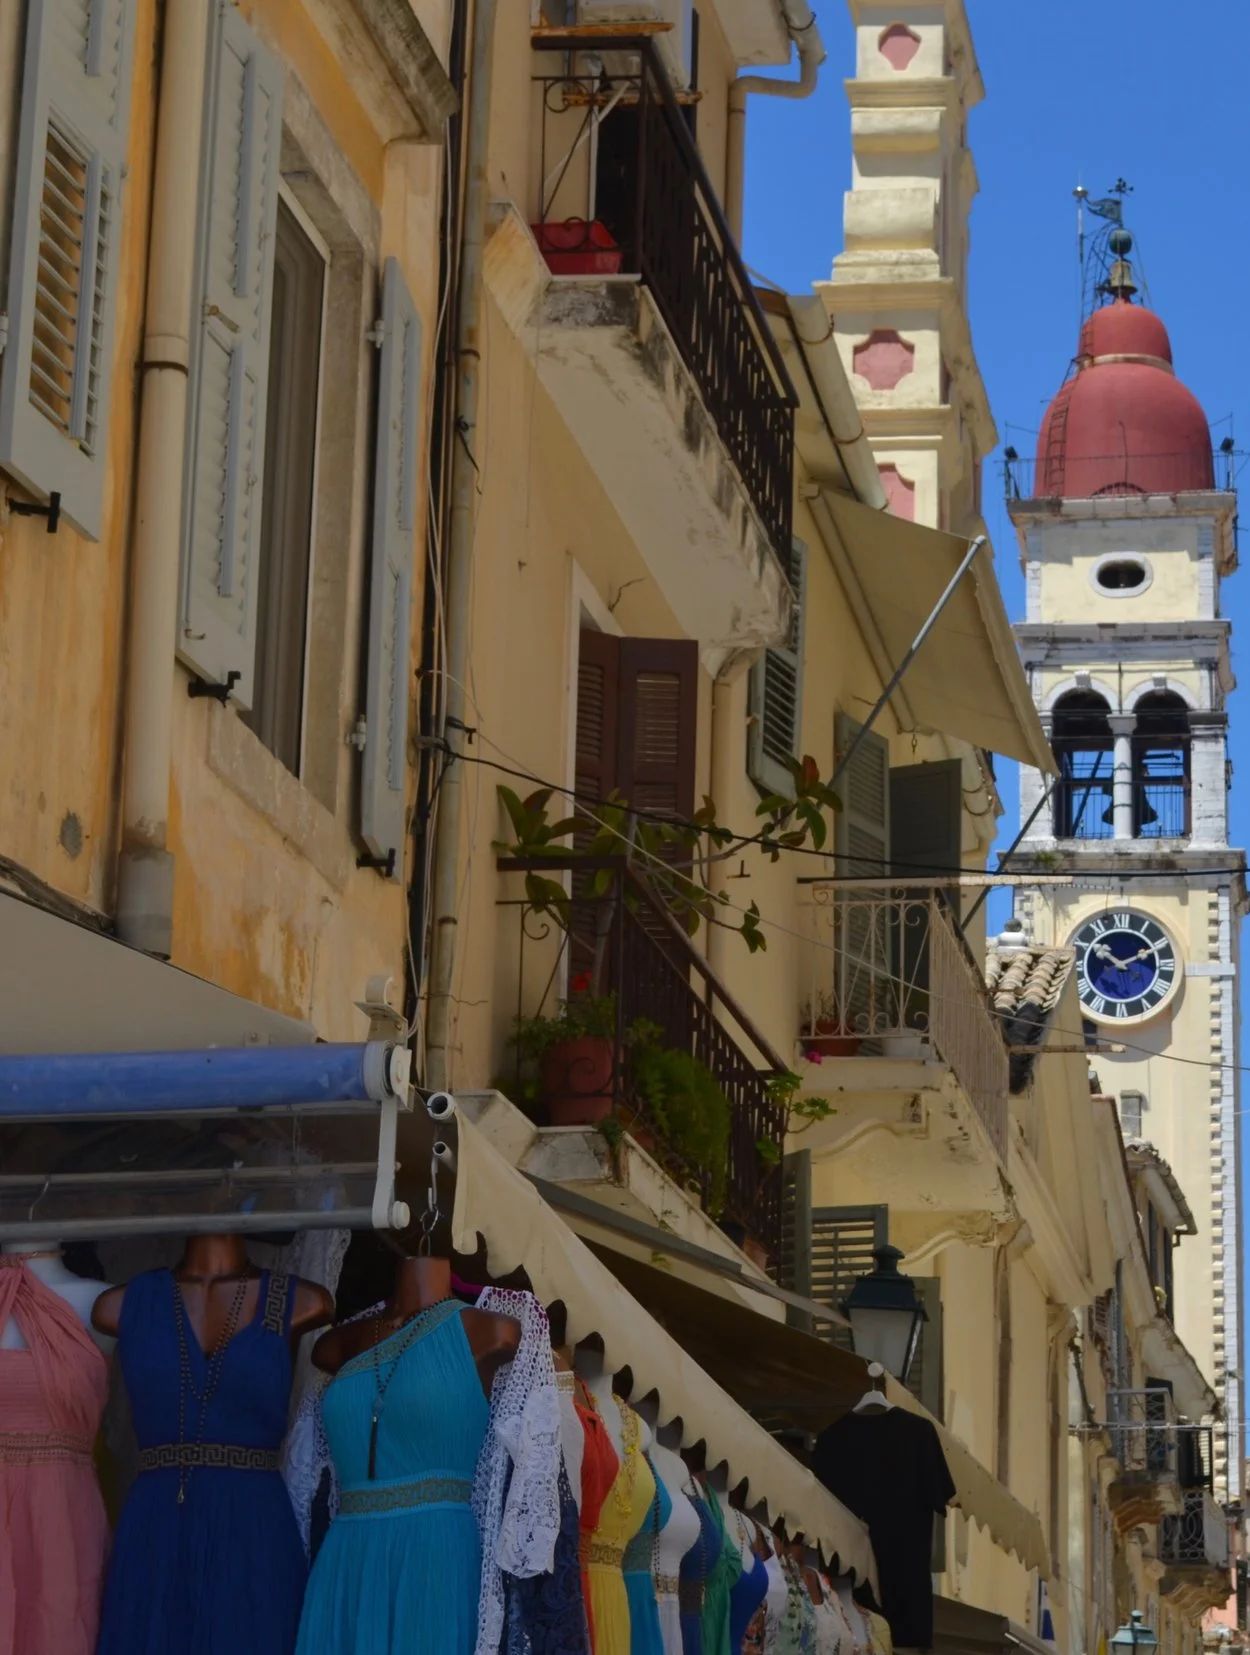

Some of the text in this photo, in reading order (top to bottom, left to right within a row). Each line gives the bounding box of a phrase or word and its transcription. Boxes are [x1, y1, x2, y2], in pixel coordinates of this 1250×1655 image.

[1090, 919, 1105, 936] XI
[1113, 913, 1130, 928] XII
[1140, 920, 1150, 934] I
[1160, 959, 1175, 970] III
[1090, 996, 1105, 1014] VII
[1116, 1003, 1128, 1018] VI
[1141, 998, 1152, 1012] V
